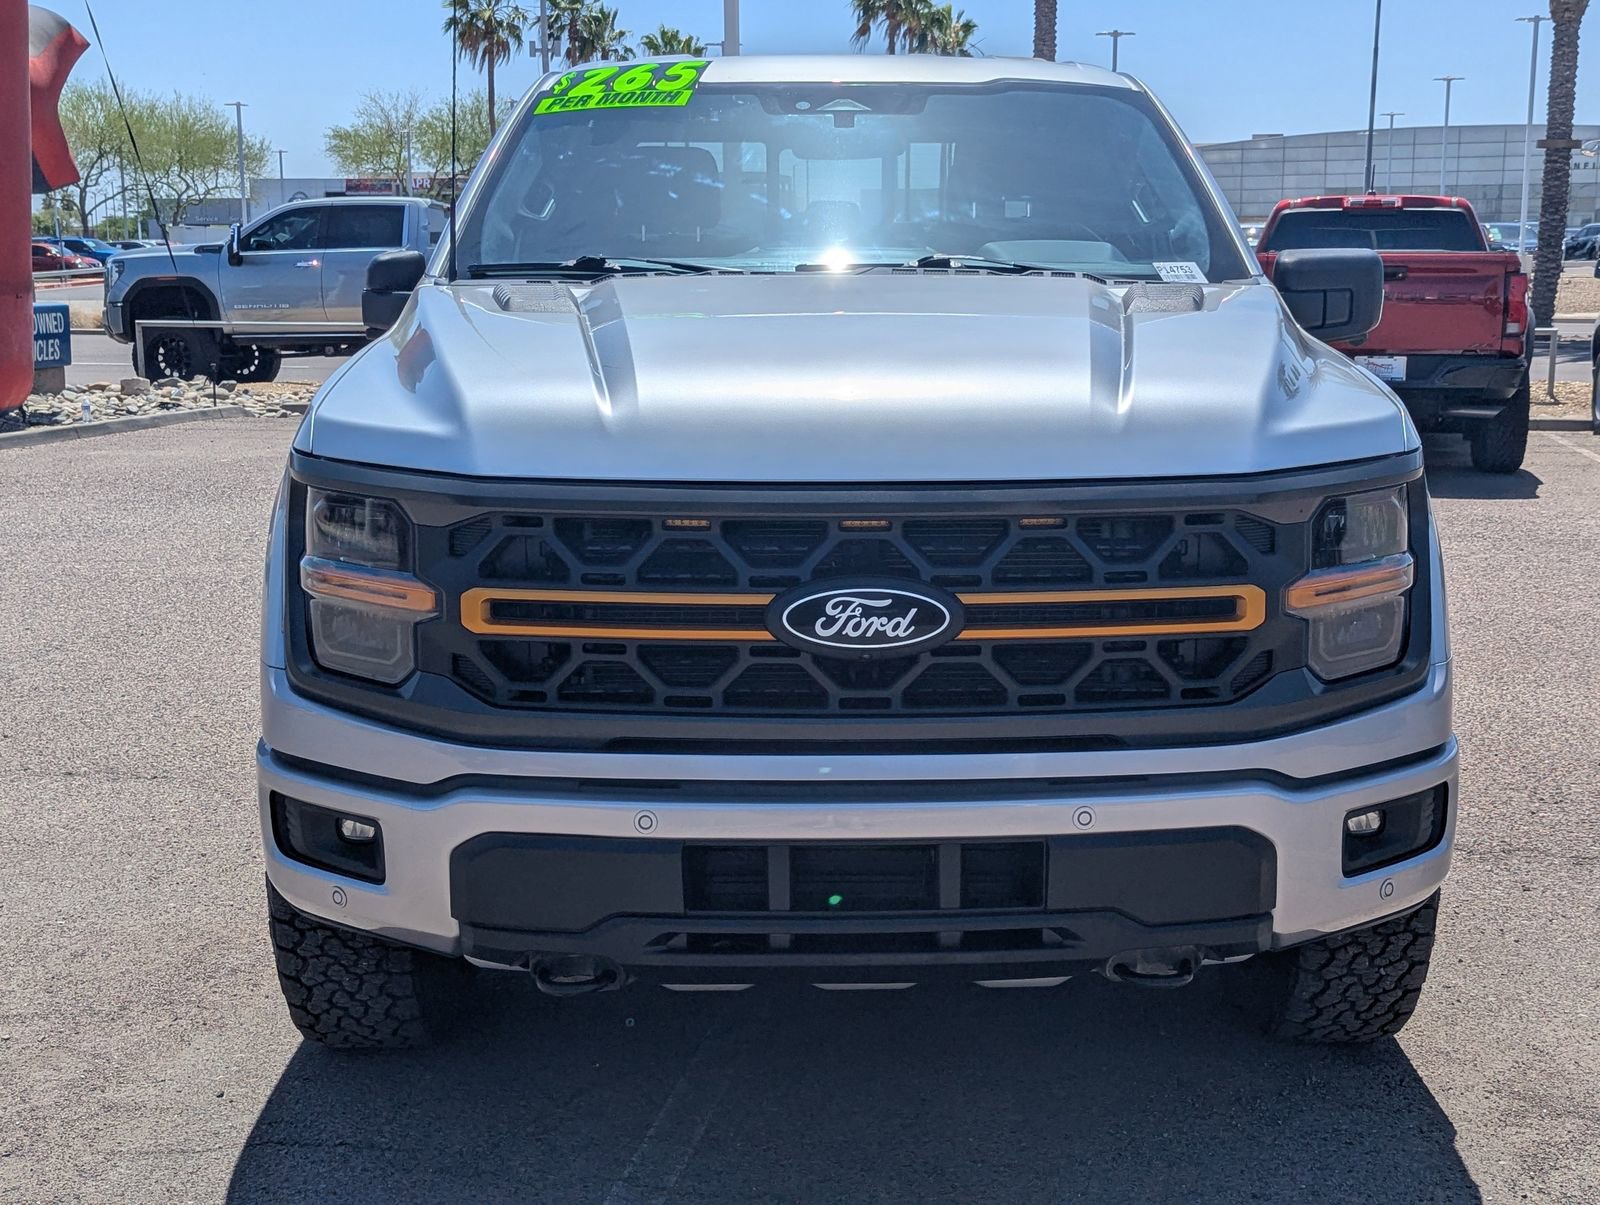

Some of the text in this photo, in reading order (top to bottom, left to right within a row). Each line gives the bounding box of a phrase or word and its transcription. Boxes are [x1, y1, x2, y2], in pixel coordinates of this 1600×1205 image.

[552, 61, 708, 96] $265
[545, 89, 682, 111] PER MONTH
[1156, 265, 1193, 274] P14753
[815, 597, 918, 637] Ford
